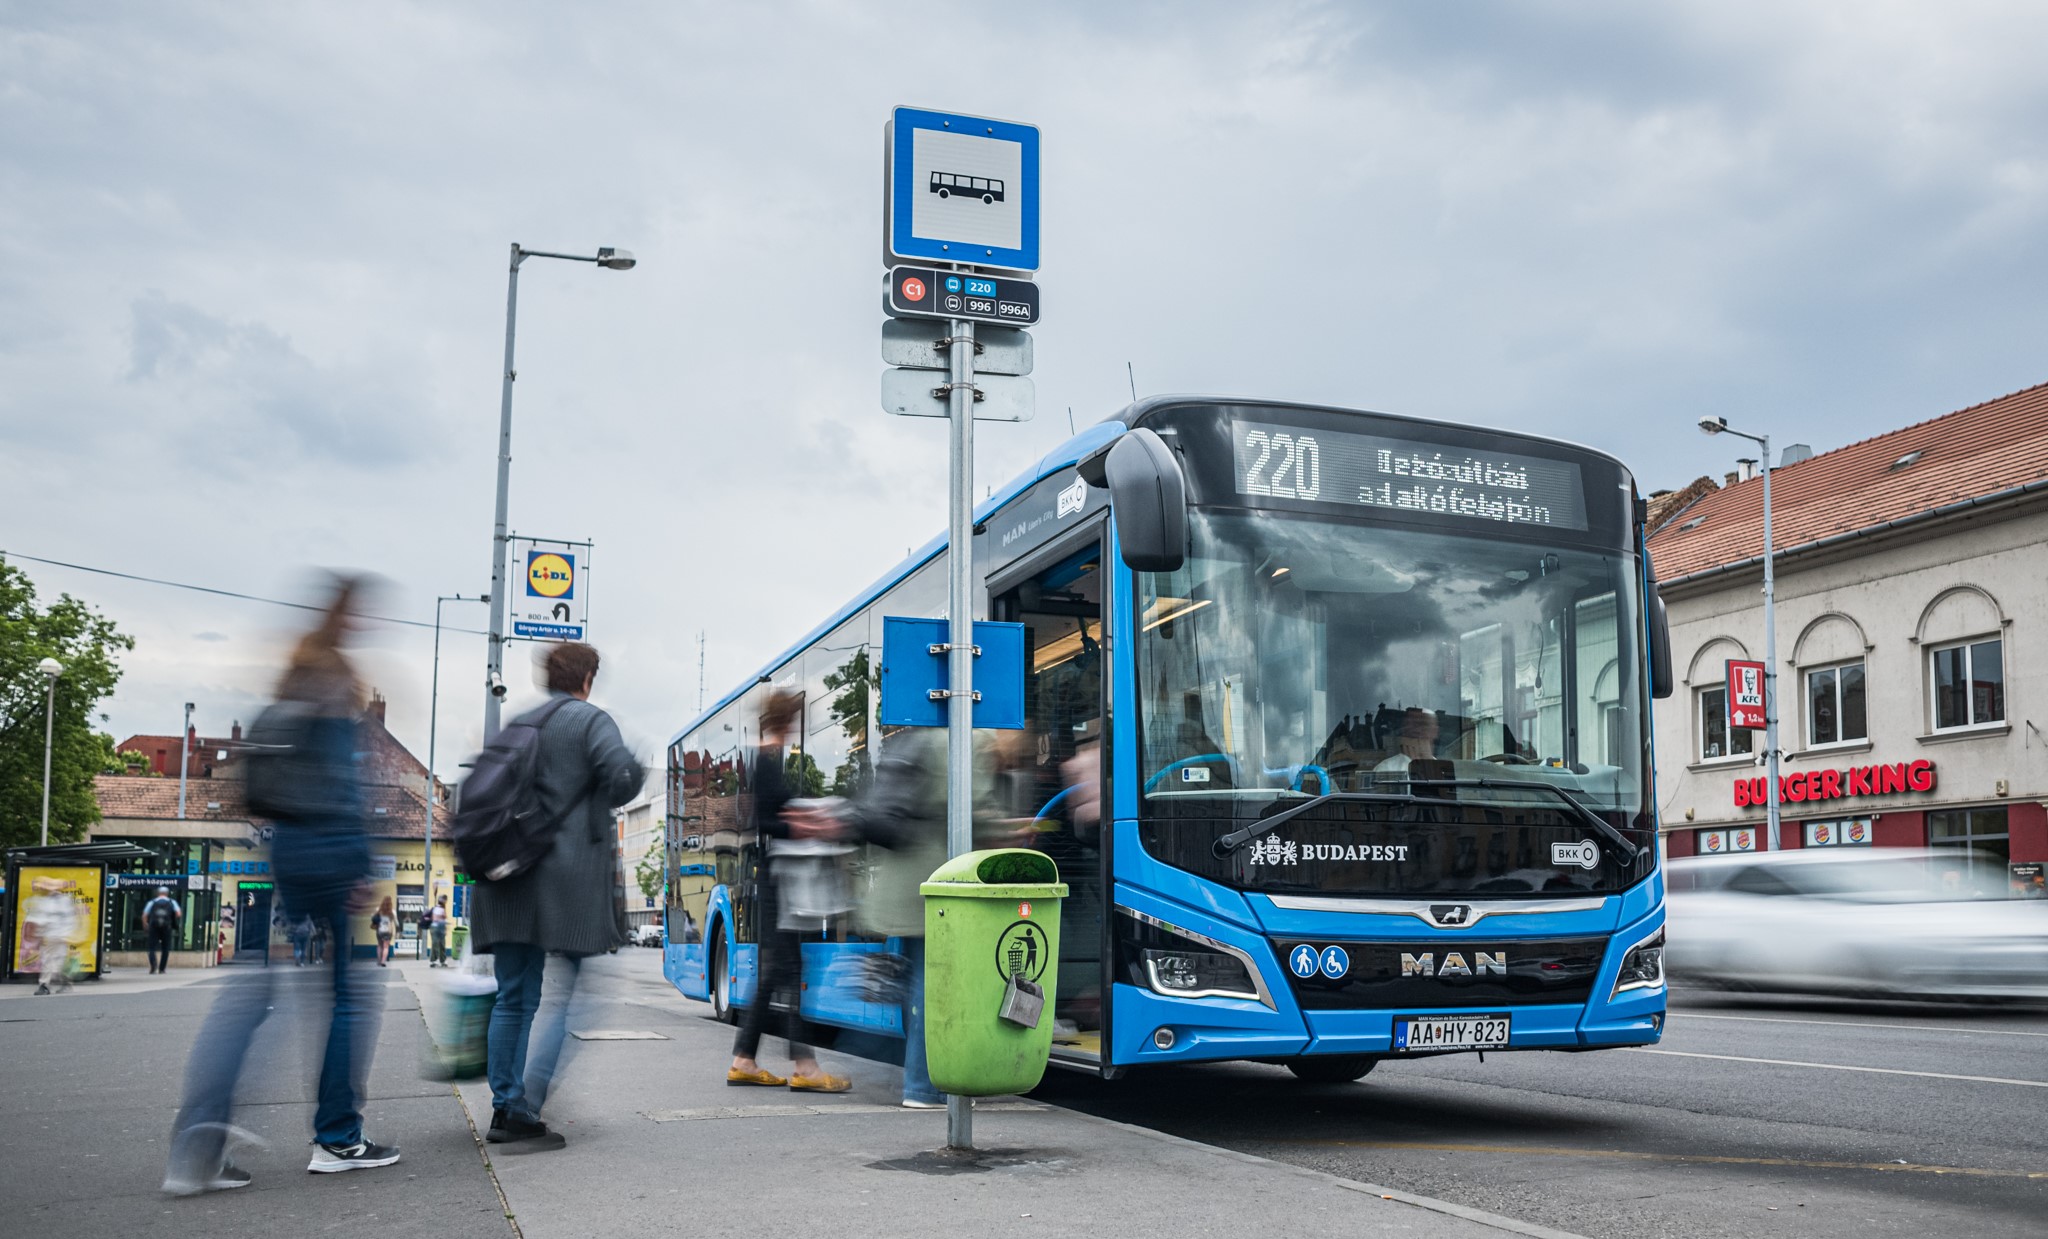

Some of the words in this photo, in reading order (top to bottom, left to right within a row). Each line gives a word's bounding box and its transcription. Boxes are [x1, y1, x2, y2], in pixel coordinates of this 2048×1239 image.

[906, 283, 921, 296] C1
[970, 282, 991, 293] 220
[970, 301, 991, 312] 996
[1000, 304, 1029, 316] 996A
[1246, 430, 1319, 500] 220
[1061, 494, 1074, 509] BKK
[1003, 522, 1026, 547] MAN
[1043, 510, 1054, 523] City
[528, 613, 542, 621] 800
[1742, 695, 1759, 704] KFC
[1850, 759, 1932, 796] KING
[1301, 844, 1408, 861] BUDAPEST
[1558, 849, 1579, 859] BKK
[1400, 952, 1507, 976] MAN
[1398, 1036, 1404, 1044] H
[1411, 1023, 1433, 1044] AA
[1443, 1021, 1506, 1043] HY-823
